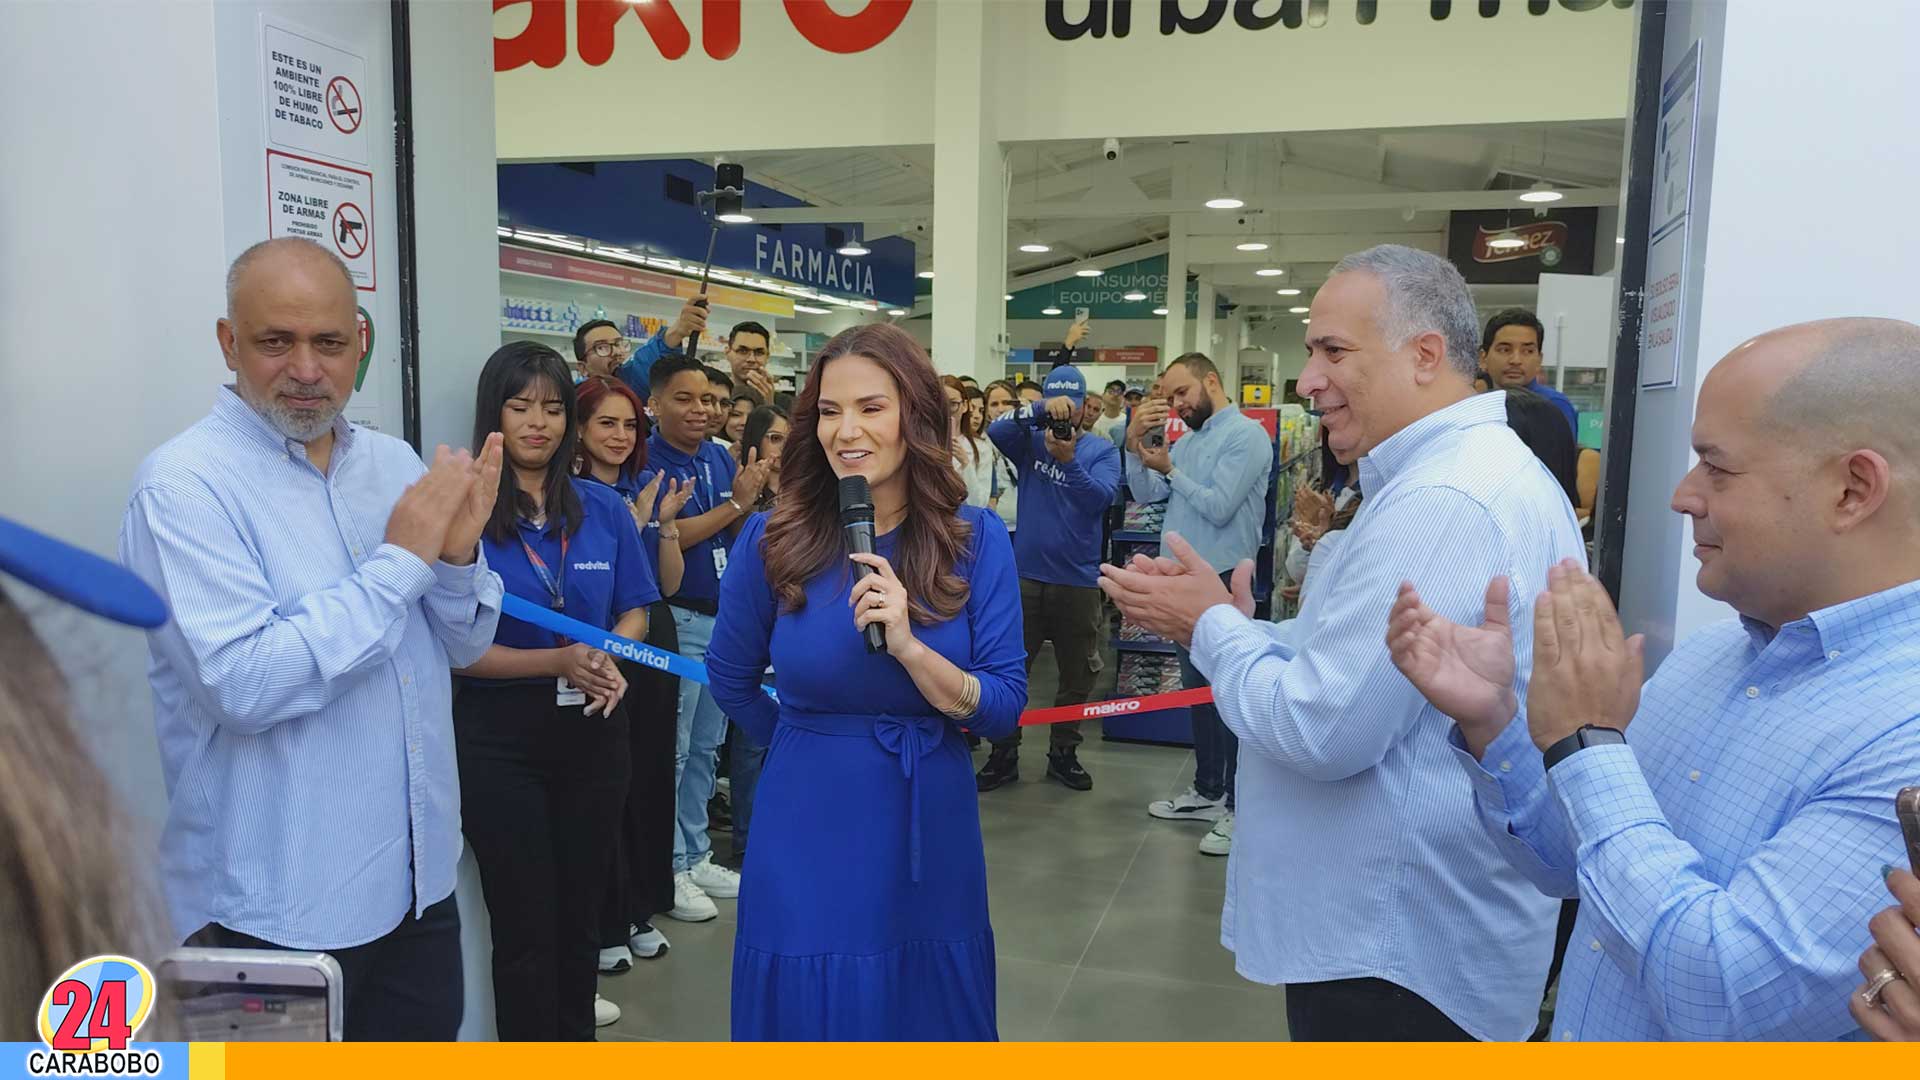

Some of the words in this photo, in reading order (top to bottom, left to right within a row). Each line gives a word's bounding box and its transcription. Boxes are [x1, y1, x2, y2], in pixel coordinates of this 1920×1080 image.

[272, 51, 294, 66] ESTE
[296, 59, 307, 70] ES
[310, 63, 321, 75] UN
[275, 67, 319, 88] AMBIENTE
[273, 80, 297, 95] 100%
[298, 88, 323, 103] LIBRE
[279, 96, 291, 107] DE
[293, 100, 318, 114] HUMO
[275, 109, 287, 120] DE
[289, 112, 323, 129] TABACO
[278, 191, 302, 204] ZONA
[304, 196, 328, 209] LIBRE
[283, 204, 294, 214] DE
[296, 206, 326, 220] ARMAS
[756, 233, 875, 296] FARMACIA
[1091, 274, 1169, 288] INSUMOS
[1047, 380, 1079, 391] redvital
[573, 560, 611, 571] redvital
[603, 639, 671, 670] redvital
[1083, 700, 1140, 717] makro
